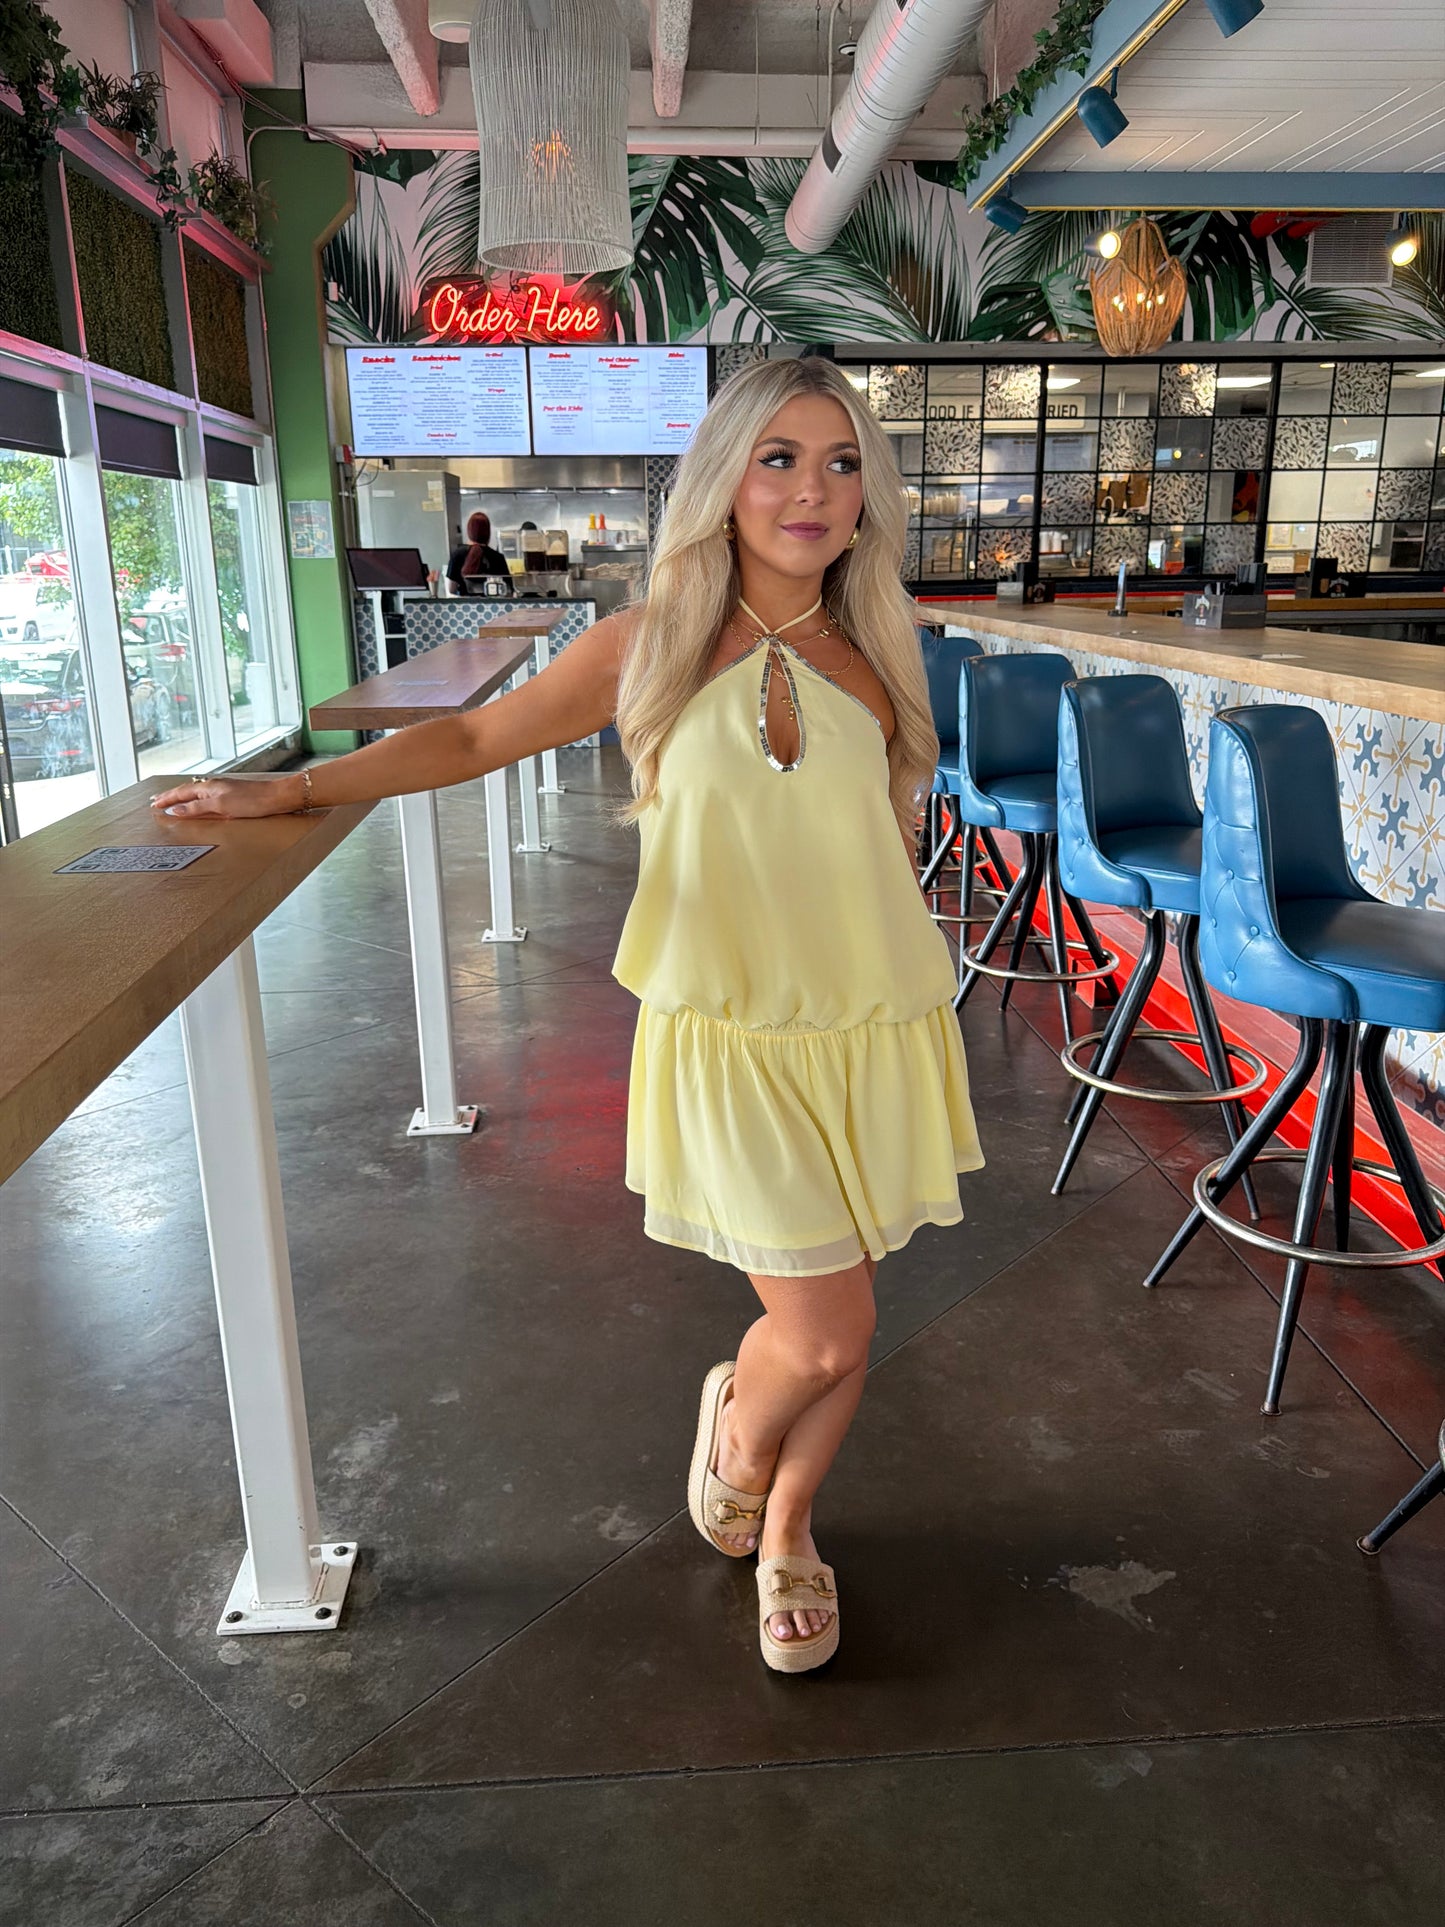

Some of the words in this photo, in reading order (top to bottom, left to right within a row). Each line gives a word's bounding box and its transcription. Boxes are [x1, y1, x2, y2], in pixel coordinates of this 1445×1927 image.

[431, 284, 520, 333] Order
[527, 287, 600, 333] Here
[411, 354, 462, 362] Sandwiches
[928, 405, 957, 419] OOD
[962, 405, 974, 419] IF
[1047, 404, 1078, 418] RIED
